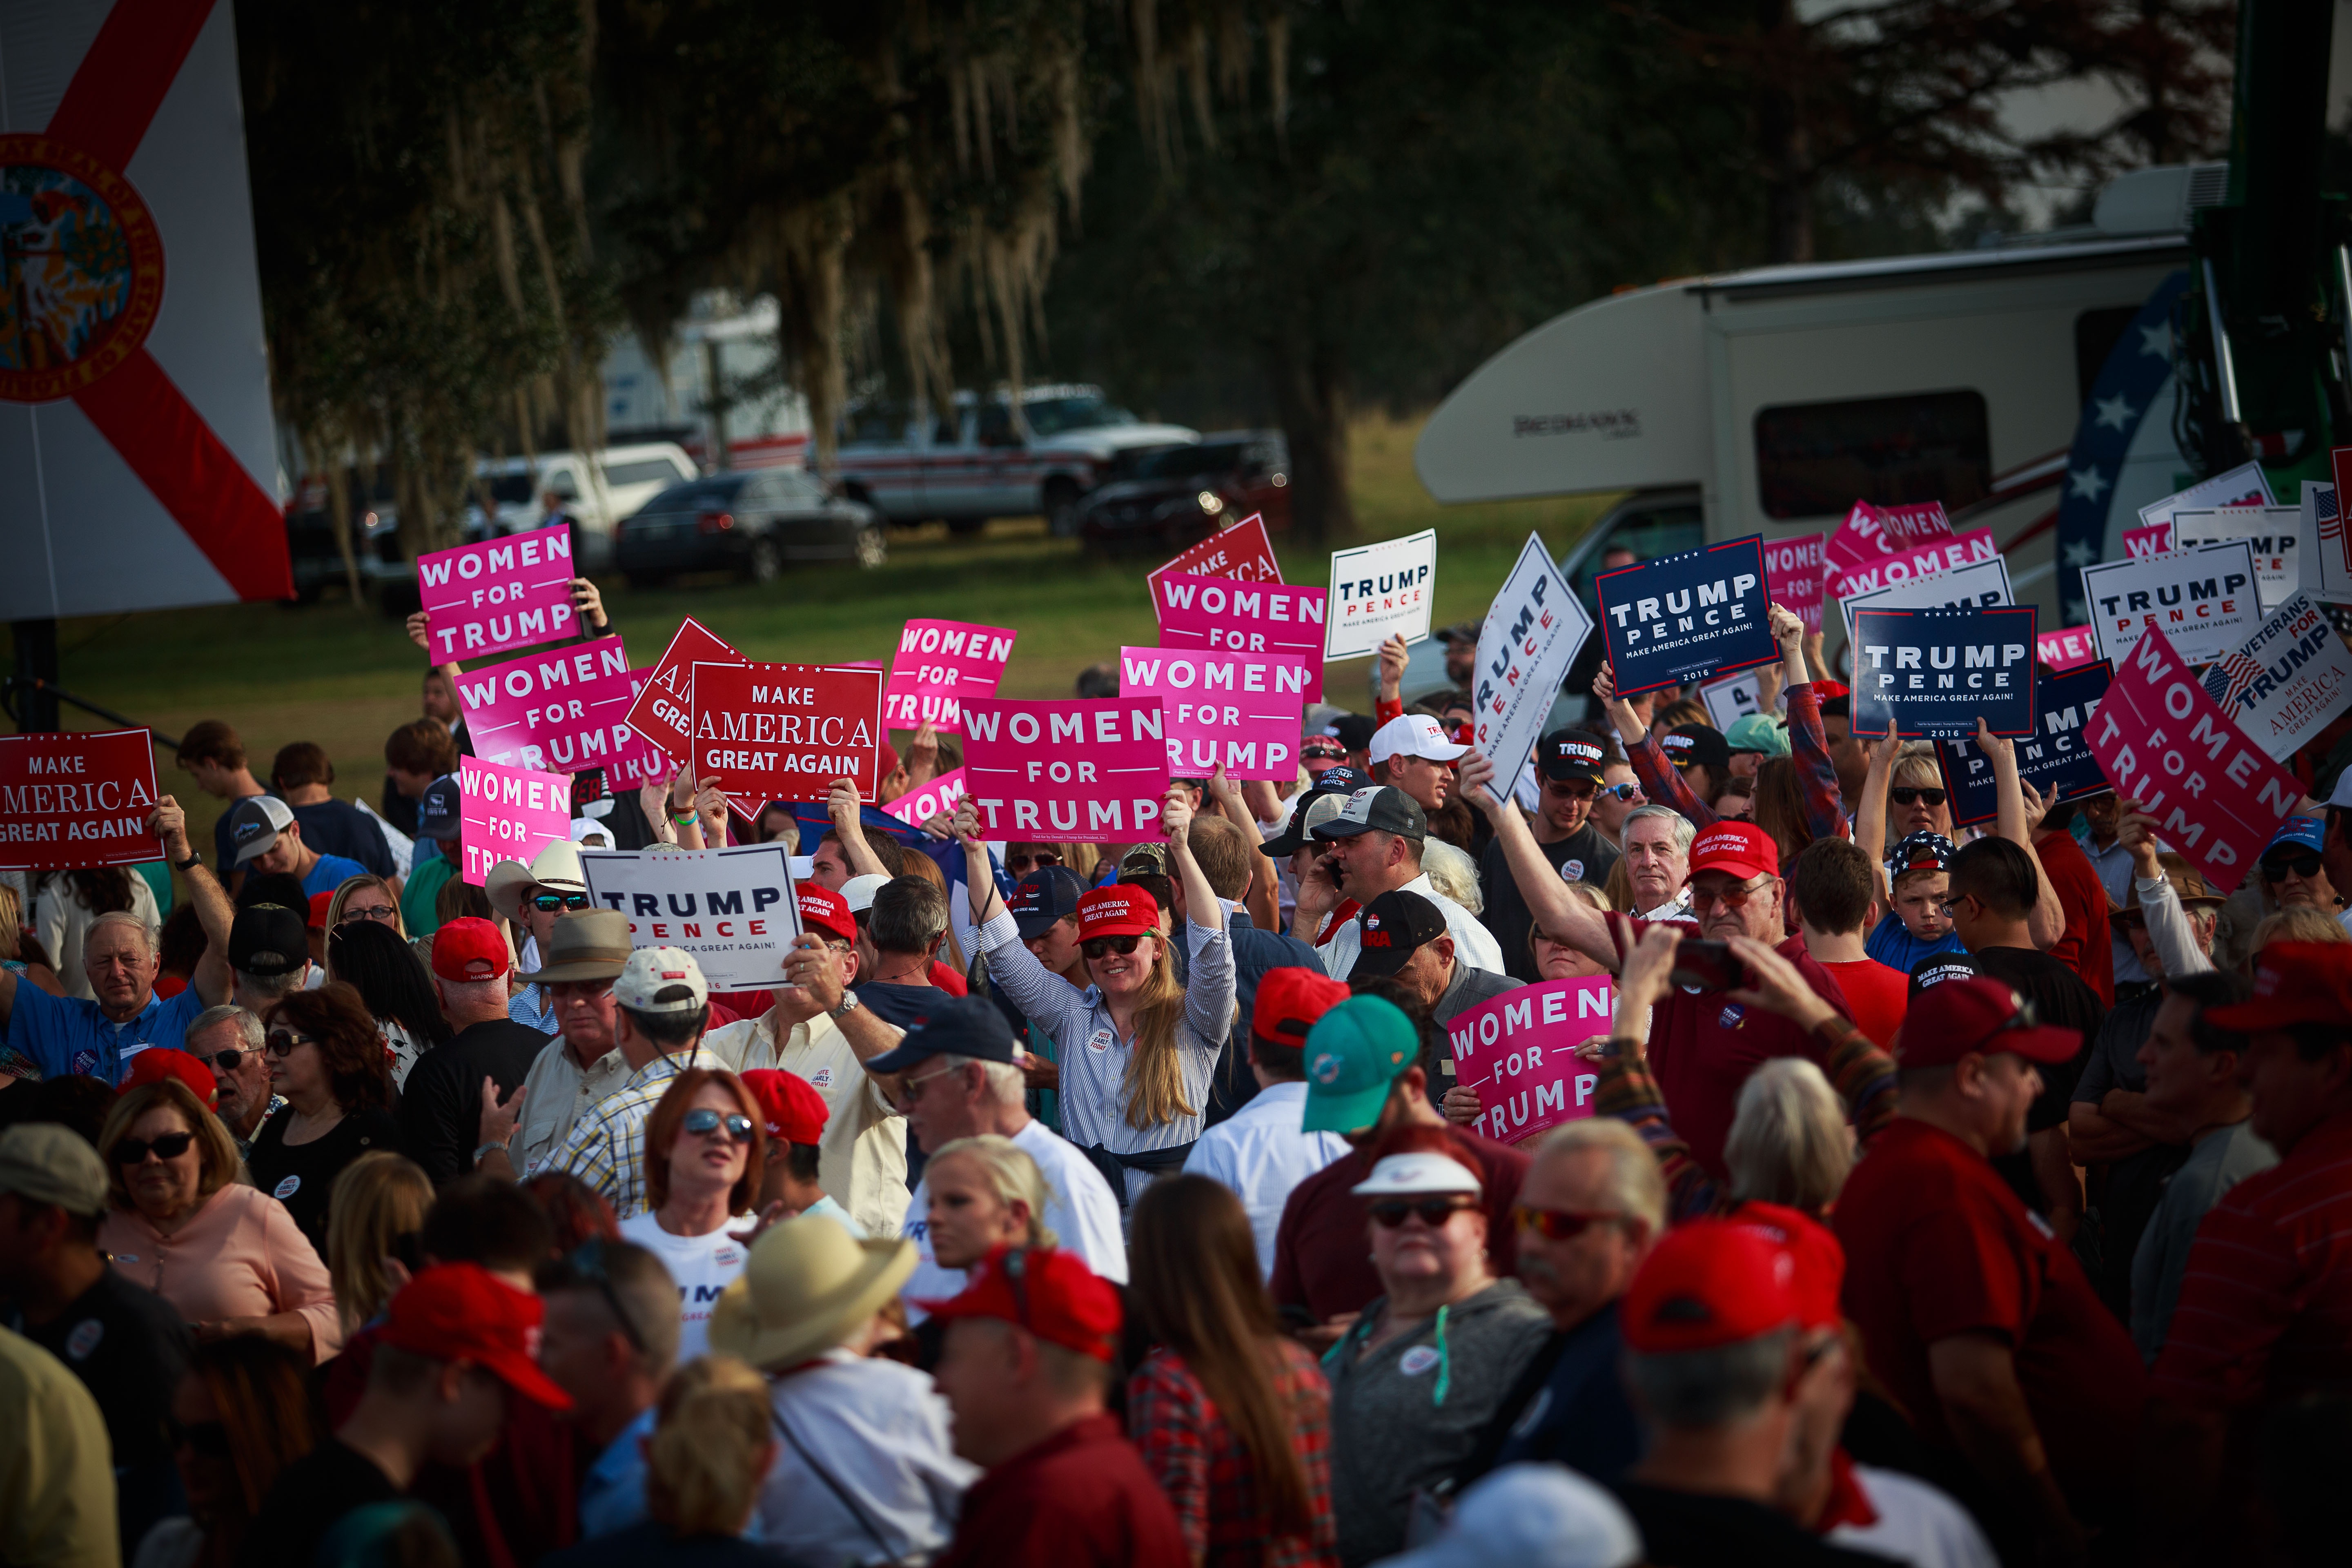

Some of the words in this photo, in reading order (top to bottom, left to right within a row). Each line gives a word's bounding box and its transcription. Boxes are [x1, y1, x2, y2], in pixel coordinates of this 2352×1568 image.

[421, 533, 570, 588] WOMEN
[472, 581, 525, 609] FOR
[1340, 565, 1428, 601] TRUMP
[2100, 573, 2246, 617] TRUMP
[1163, 580, 1324, 624] WOMEN
[1347, 589, 1421, 617] PENCE
[1610, 573, 1756, 628] TRUMP
[437, 603, 572, 654] TRUMP
[1627, 603, 1746, 645] PENCE
[2117, 599, 2236, 633] PENCE
[2182, 621, 2210, 633] GREAT
[2213, 616, 2243, 628] AGAIN!
[2241, 595, 2310, 661] VETERANS
[2288, 609, 2320, 639] FOR
[900, 628, 1013, 664] WOMEN
[1209, 628, 1265, 652] FOR
[1477, 574, 1548, 714] RUMP
[1626, 646, 1650, 659] MAKE
[1652, 638, 1690, 654] AMERICA
[1692, 630, 1719, 644] GREAT
[1722, 623, 1753, 636] AGAIN!
[2116, 633, 2139, 645] MAKE
[1864, 644, 2026, 669] TRUMP
[2235, 623, 2329, 711] TRUMP
[459, 646, 628, 710] WOMEN
[916, 665, 960, 686] FOR
[1123, 657, 1303, 694] WOMEN
[1477, 609, 1553, 744] PENCE
[1487, 727, 1505, 759] MAKE
[1501, 686, 1526, 728] AMERICA
[1523, 653, 1543, 686] GREAT
[1543, 619, 1564, 653] AGAIN!
[1683, 670, 1709, 681] 2016
[1879, 672, 2009, 689] PENCE
[2285, 675, 2309, 699] MAKE
[752, 685, 814, 705] MAKE
[886, 694, 960, 725] TRUM
[1873, 694, 1901, 702] MAKE
[1903, 694, 1946, 702] AMERICA
[1950, 694, 1979, 702] GREAT
[1982, 693, 2013, 701] AGAIN!
[2268, 665, 2346, 737] AMERICA
[526, 699, 585, 729] FOR
[962, 708, 1163, 744] WOMEN
[1178, 704, 1240, 726] FOR
[1536, 700, 1551, 729] 2016
[2136, 632, 2297, 820] WOMEN
[2288, 709, 2314, 736] GREAT
[2315, 687, 2342, 713] AGAIN!
[695, 710, 874, 748] AMERICA
[1427, 726, 1442, 735] TRU
[488, 724, 632, 771] TRUMP
[706, 748, 778, 771] GREAT
[784, 753, 859, 775] AGAIN
[1167, 739, 1289, 770] RUMP
[1559, 743, 1603, 760] TRUMP
[29, 756, 86, 774] MAKE
[1027, 761, 1098, 783] FOR
[1323, 768, 1353, 779] TRUMP
[2042, 755, 2071, 770] GREAT
[2146, 727, 2207, 800] FOR
[2, 778, 154, 814] MERICA
[461, 765, 569, 814] WOMEN
[1968, 776, 1996, 788] MAKE
[2097, 713, 2238, 866] TRUMP
[894, 777, 964, 826] WOM
[978, 799, 1159, 831] TRUMP
[67, 817, 143, 841] AGAIN
[489, 816, 526, 842] FOR
[1695, 836, 1713, 849] MAKE
[1713, 834, 1748, 844] AMERICA
[1697, 844, 1719, 856] GREAT
[1719, 844, 1745, 853] AGAIN
[600, 887, 781, 917] TRUMP
[800, 895, 835, 910] AMERICA
[806, 907, 831, 917] AGAIN
[1082, 904, 1096, 915] MAKE
[1097, 900, 1130, 910] AMERICA
[1085, 911, 1103, 922] GREAT
[1104, 909, 1127, 918] AGAIN
[700, 942, 734, 952] GREAT
[738, 941, 776, 951] AGAIN!
[1361, 930, 1392, 947] NRA
[1917, 967, 1938, 982] MAKE
[1939, 964, 1974, 975] AMERICA
[1922, 973, 1945, 988] GREAT
[1946, 973, 1970, 982] AGAIN
[1098, 1031, 1111, 1039] VOTE
[1450, 987, 1609, 1062] WOMEN
[80, 1051, 96, 1065] TRUMP
[1090, 1042, 1106, 1051] TODAY
[77, 1056, 91, 1069] PENCE
[1493, 1045, 1543, 1085] FOR
[1472, 1073, 1599, 1140] TRUMP
